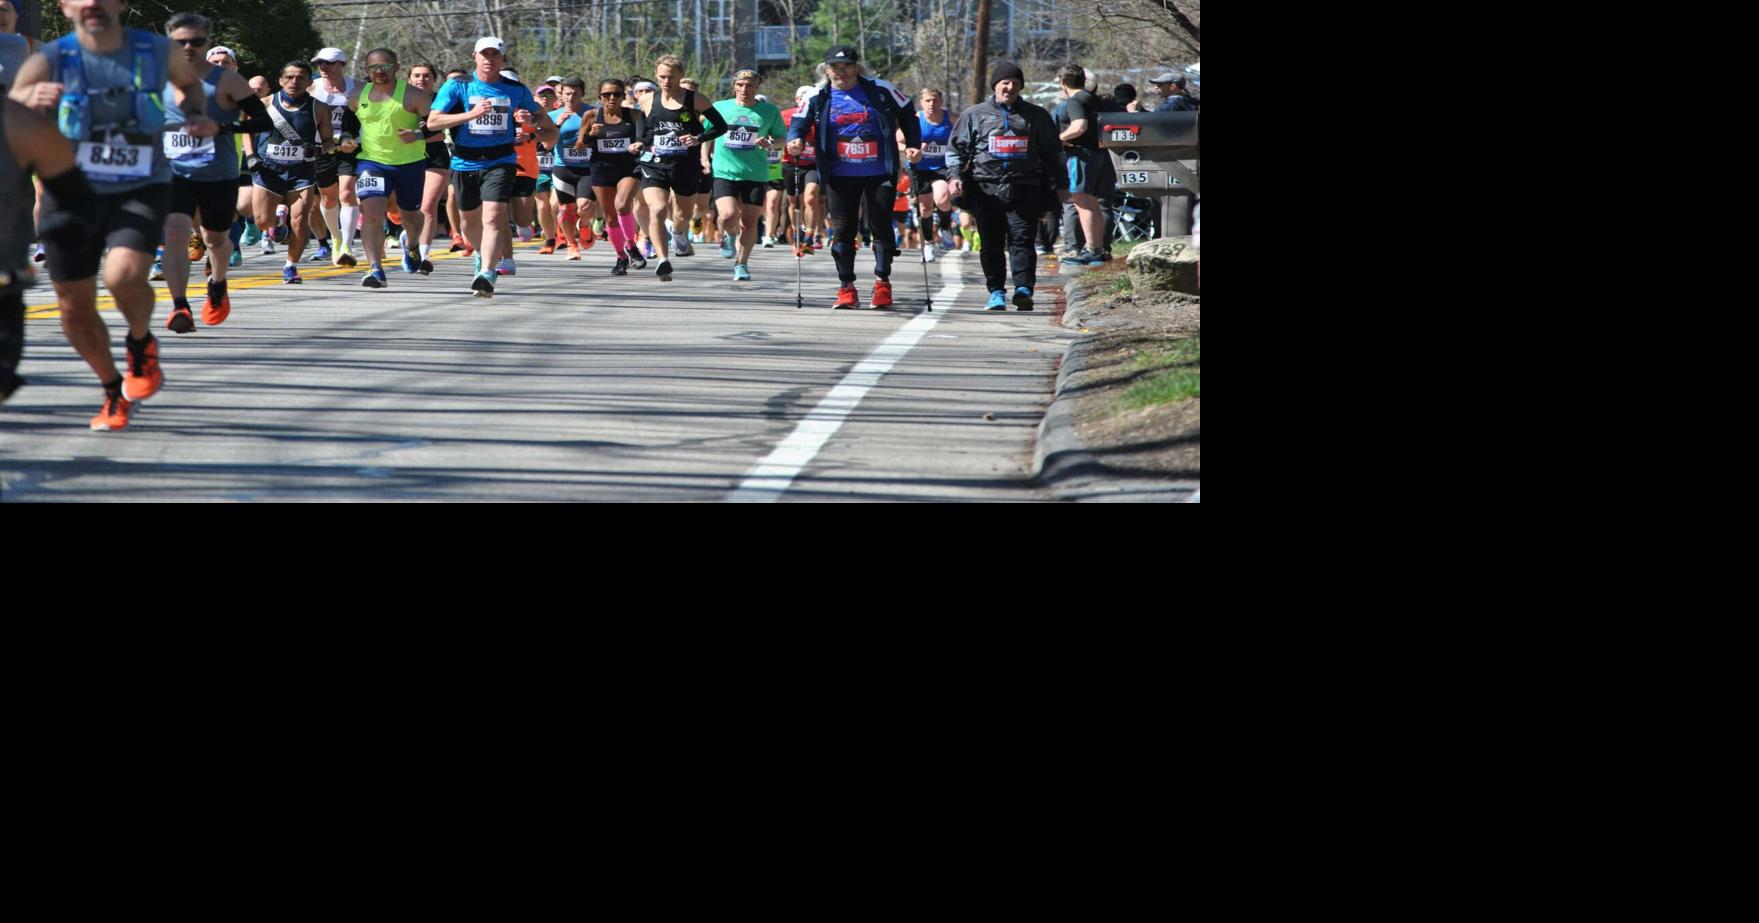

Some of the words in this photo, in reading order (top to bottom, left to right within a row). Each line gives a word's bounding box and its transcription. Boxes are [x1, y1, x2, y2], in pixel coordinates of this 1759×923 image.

[729, 132, 753, 142] 8507
[1114, 131, 1135, 140] 139
[603, 139, 625, 148] 8522
[996, 139, 1028, 148] SUPPORT
[1122, 173, 1147, 183] 135
